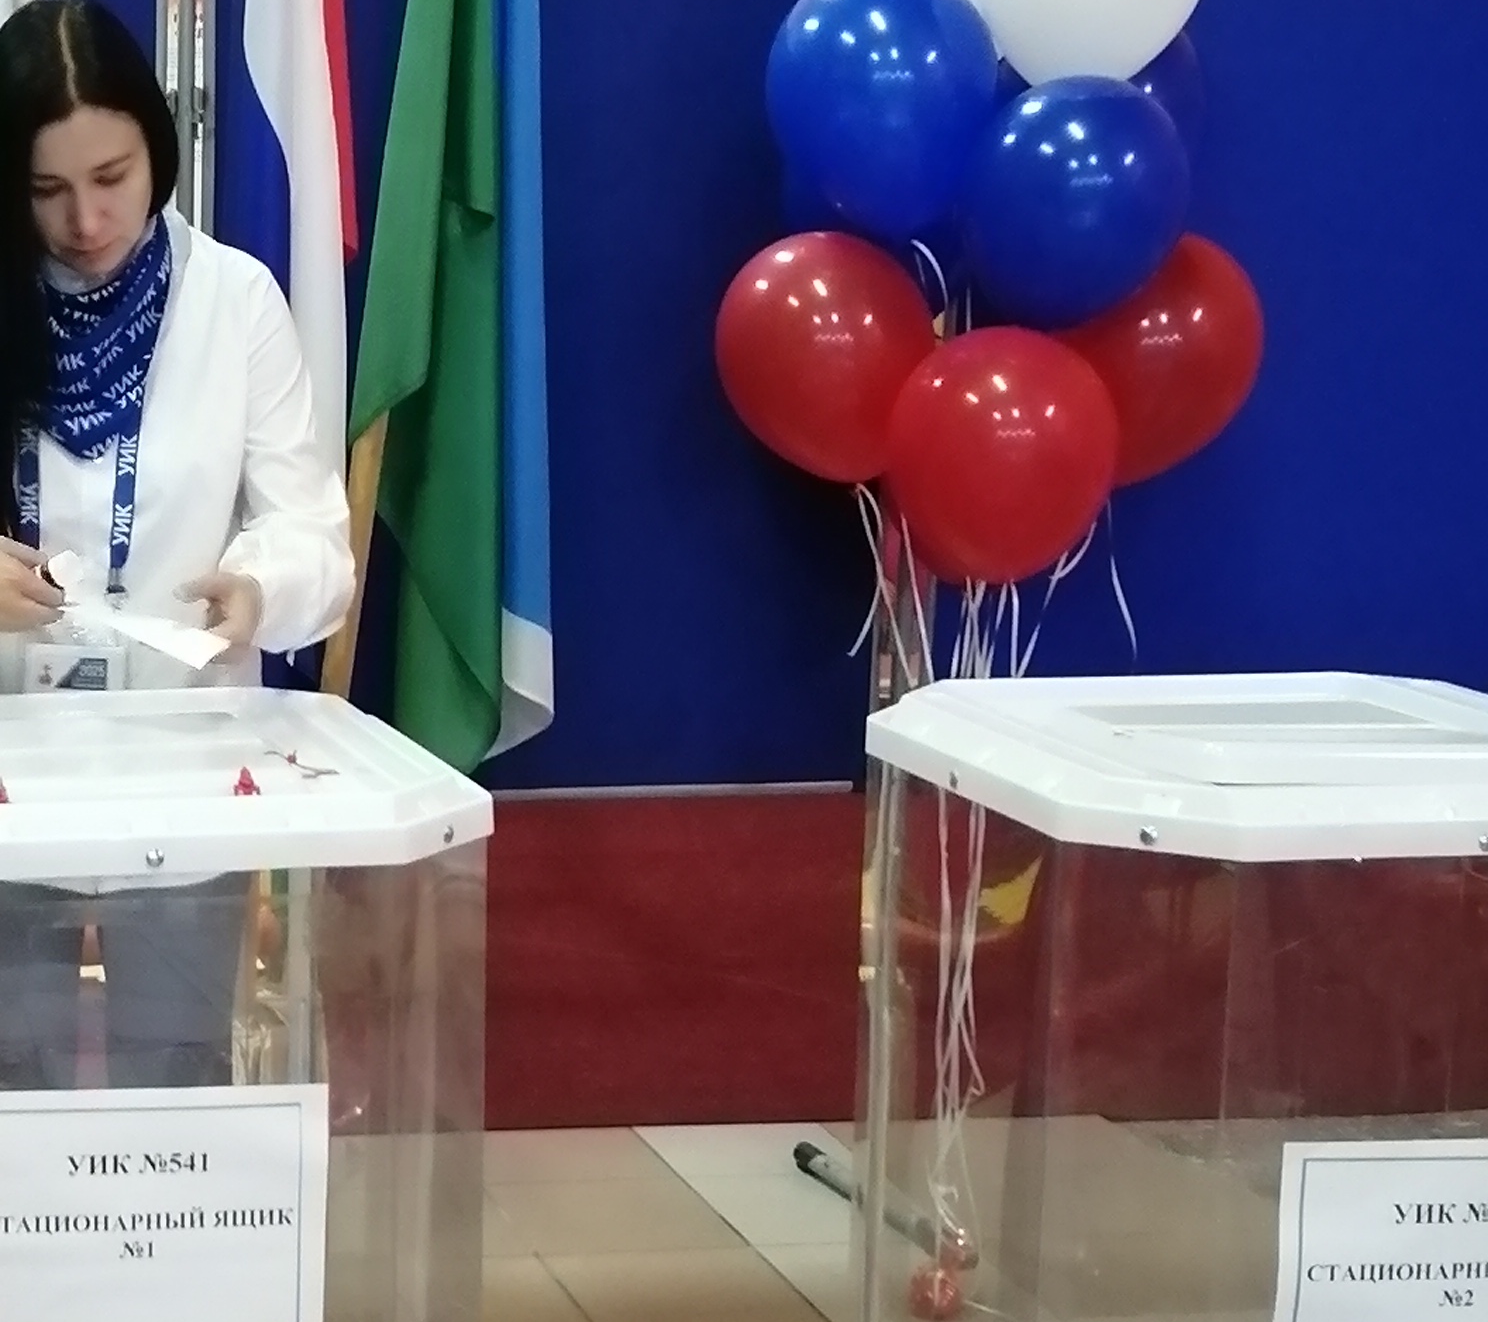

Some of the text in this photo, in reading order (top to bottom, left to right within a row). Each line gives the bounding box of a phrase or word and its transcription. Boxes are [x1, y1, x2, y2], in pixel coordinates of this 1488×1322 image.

[125, 305, 163, 343] УИК
[101, 363, 143, 401] УИК
[117, 433, 138, 476] УИК
[19, 482, 39, 524] УИК
[111, 503, 134, 546] УИК
[66, 1152, 210, 1176] УИК №541
[213, 1207, 294, 1231] ЯЩИК
[1394, 1203, 1457, 1224] УИК
[119, 1241, 155, 1259] №1
[1438, 1289, 1474, 1308] №2
